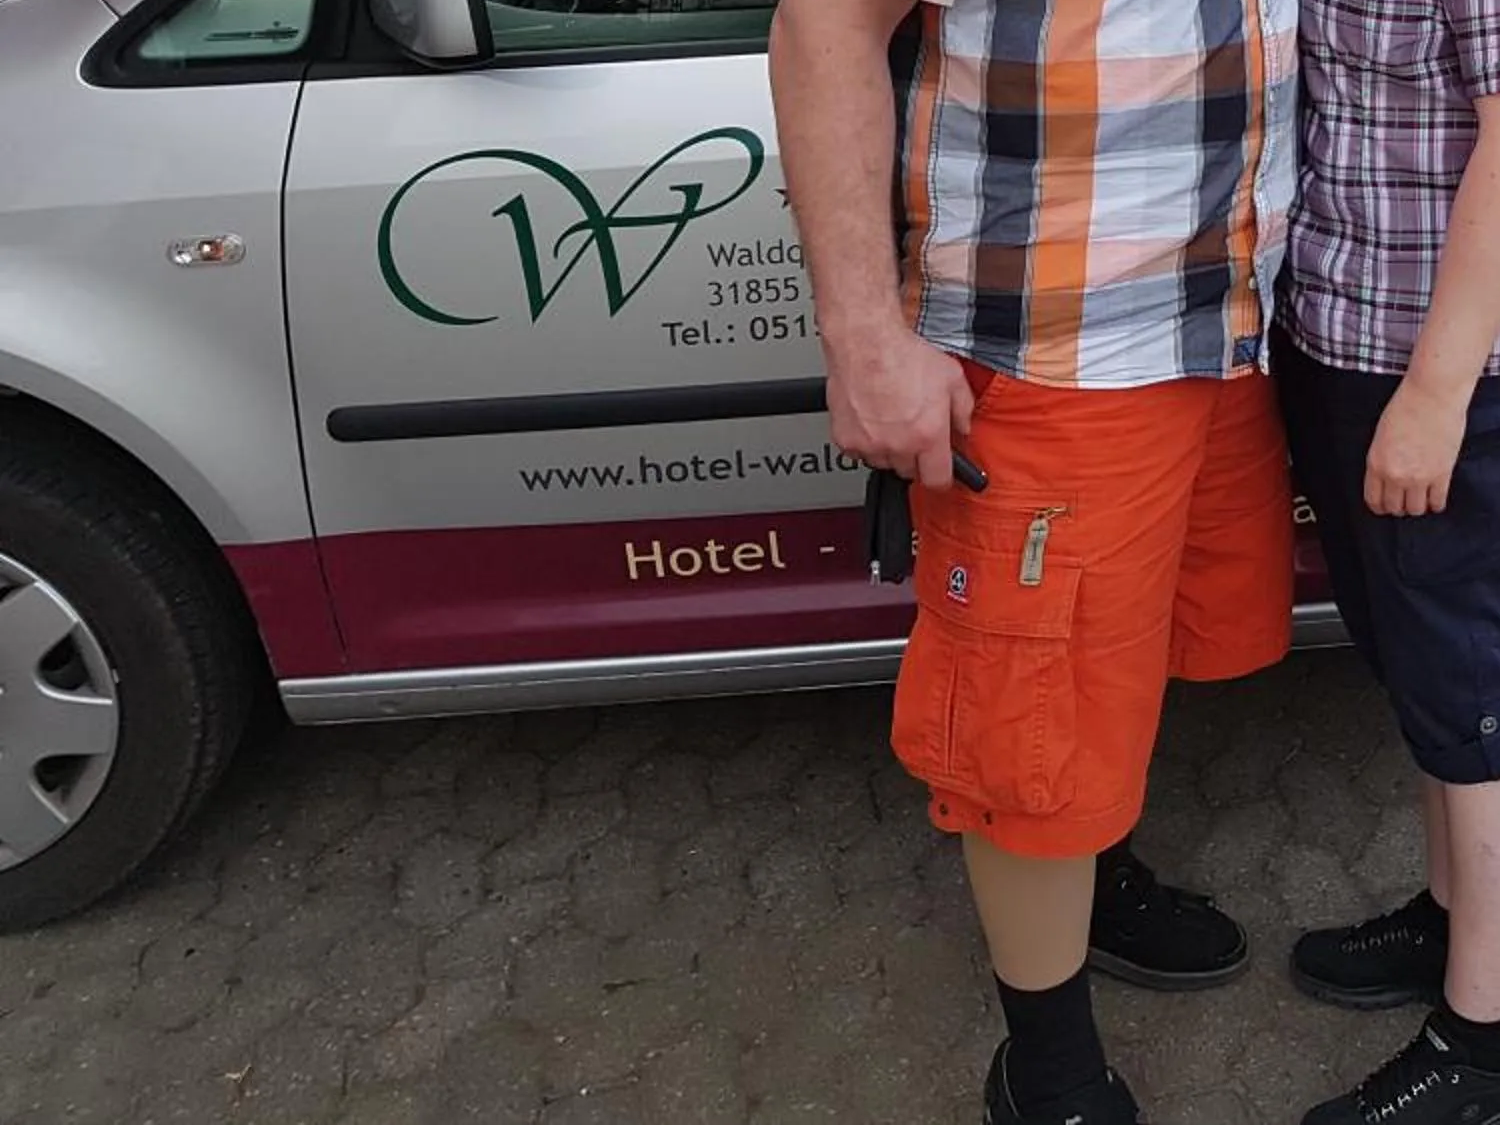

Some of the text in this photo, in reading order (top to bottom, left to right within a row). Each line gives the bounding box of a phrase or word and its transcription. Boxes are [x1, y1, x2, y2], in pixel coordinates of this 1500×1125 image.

[706, 238, 805, 269] Waldq
[707, 276, 799, 306] 31855
[661, 314, 821, 347] Tel.: 051
[519, 442, 868, 491] www.hotel-wald
[624, 530, 787, 580] Hotel
